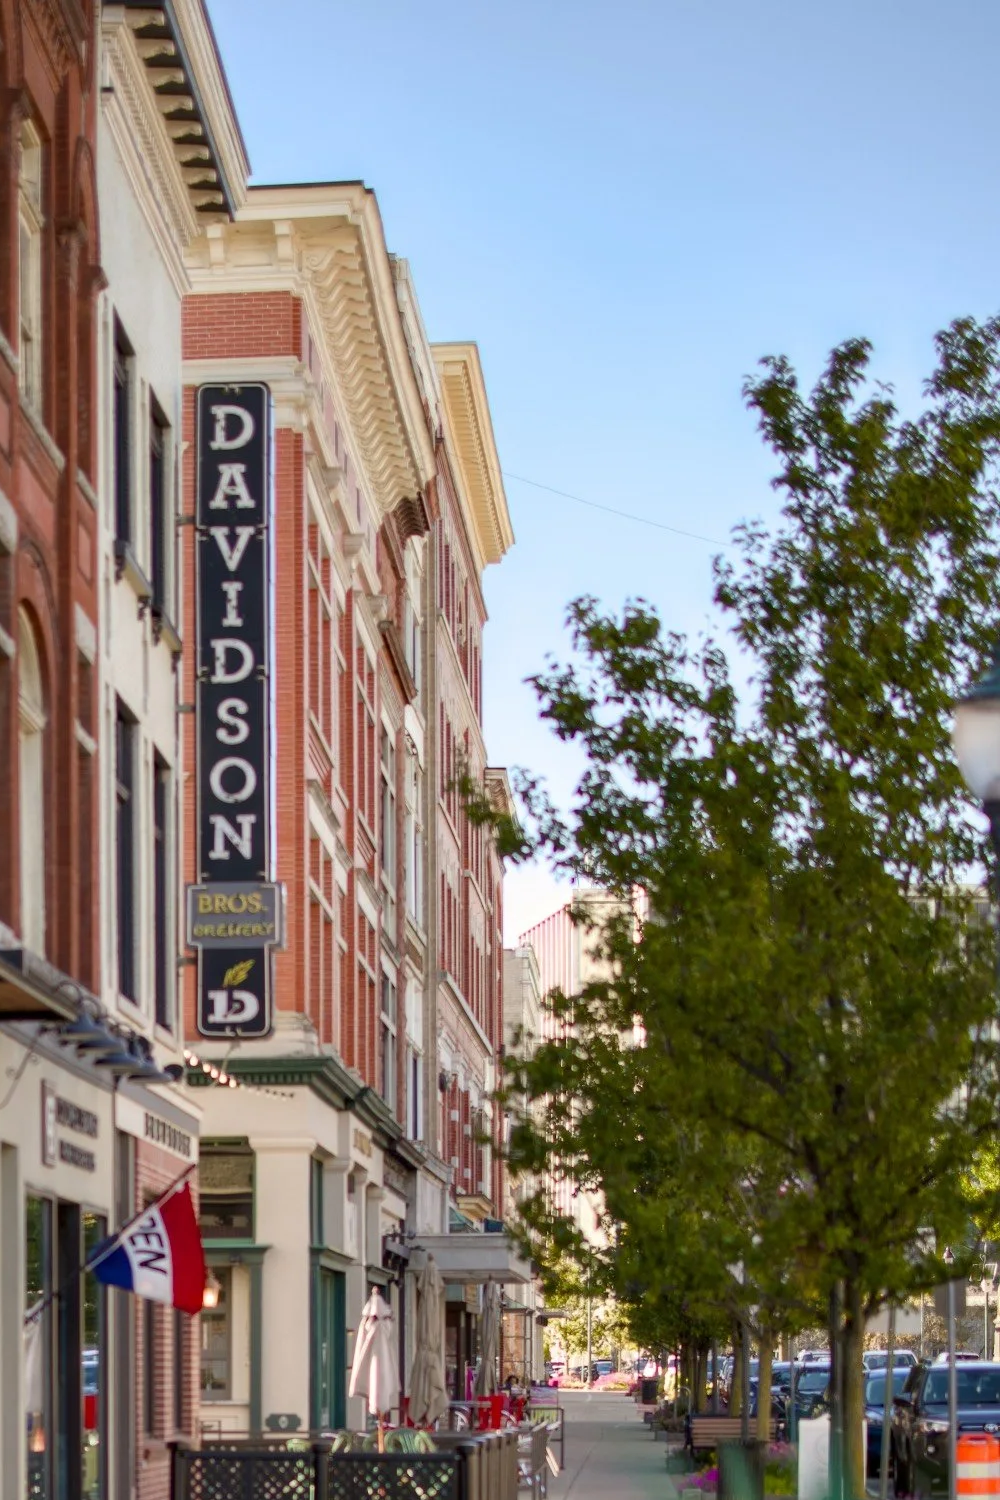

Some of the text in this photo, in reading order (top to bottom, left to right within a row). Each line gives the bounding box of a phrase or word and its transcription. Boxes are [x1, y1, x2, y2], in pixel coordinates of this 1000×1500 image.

[208, 403, 257, 861] DAVIDSON
[197, 892, 269, 914] BROS.
[128, 1215, 169, 1275] EN
